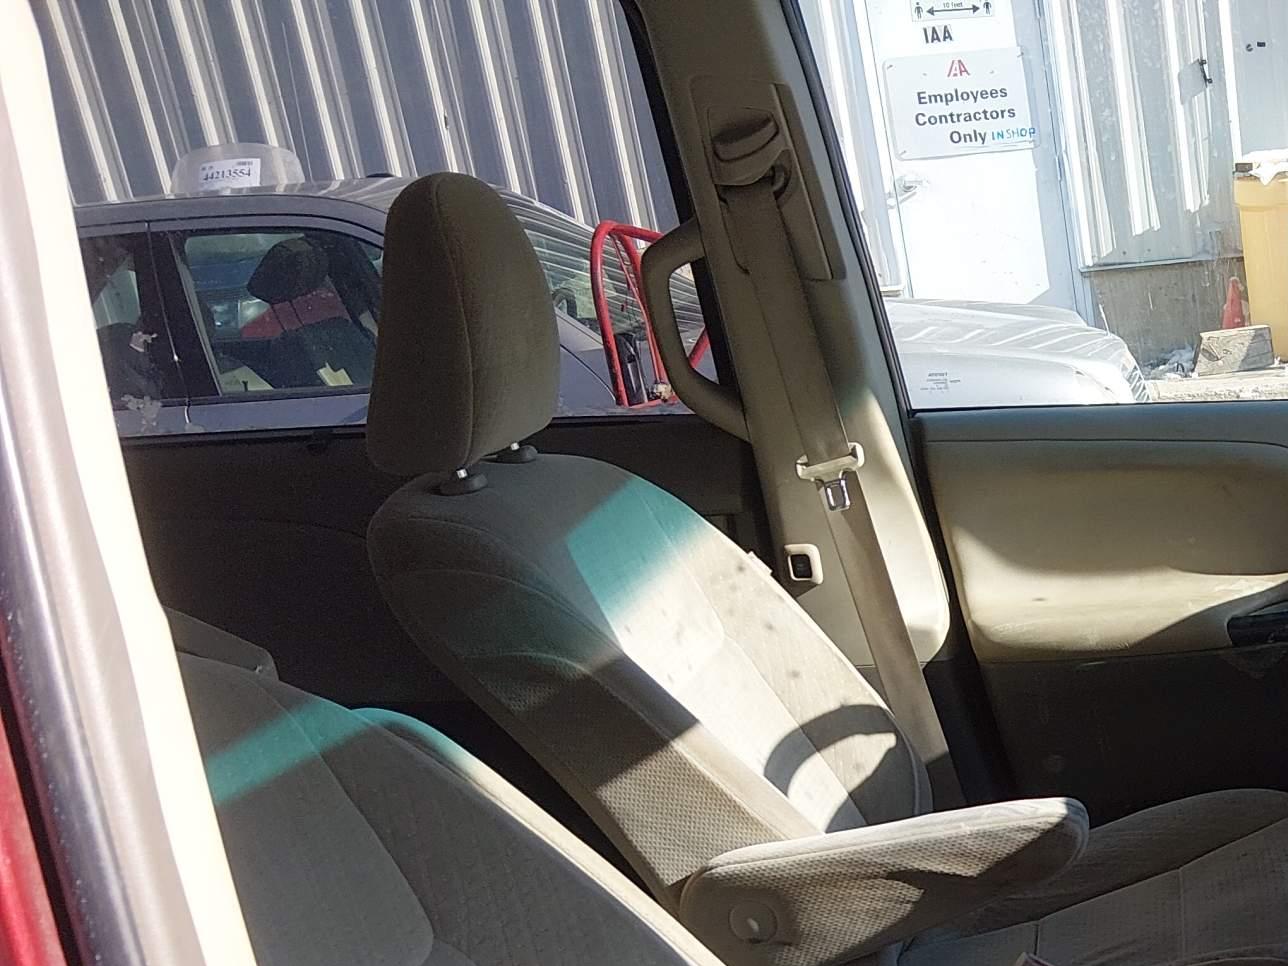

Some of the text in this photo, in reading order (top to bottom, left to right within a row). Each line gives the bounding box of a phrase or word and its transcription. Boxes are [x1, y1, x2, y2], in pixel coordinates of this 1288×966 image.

[923, 25, 953, 44] IAA
[917, 87, 1008, 106] Employees
[915, 107, 1016, 126] Contractors
[949, 129, 987, 145] Only
[991, 127, 1036, 141] IN SHOP
